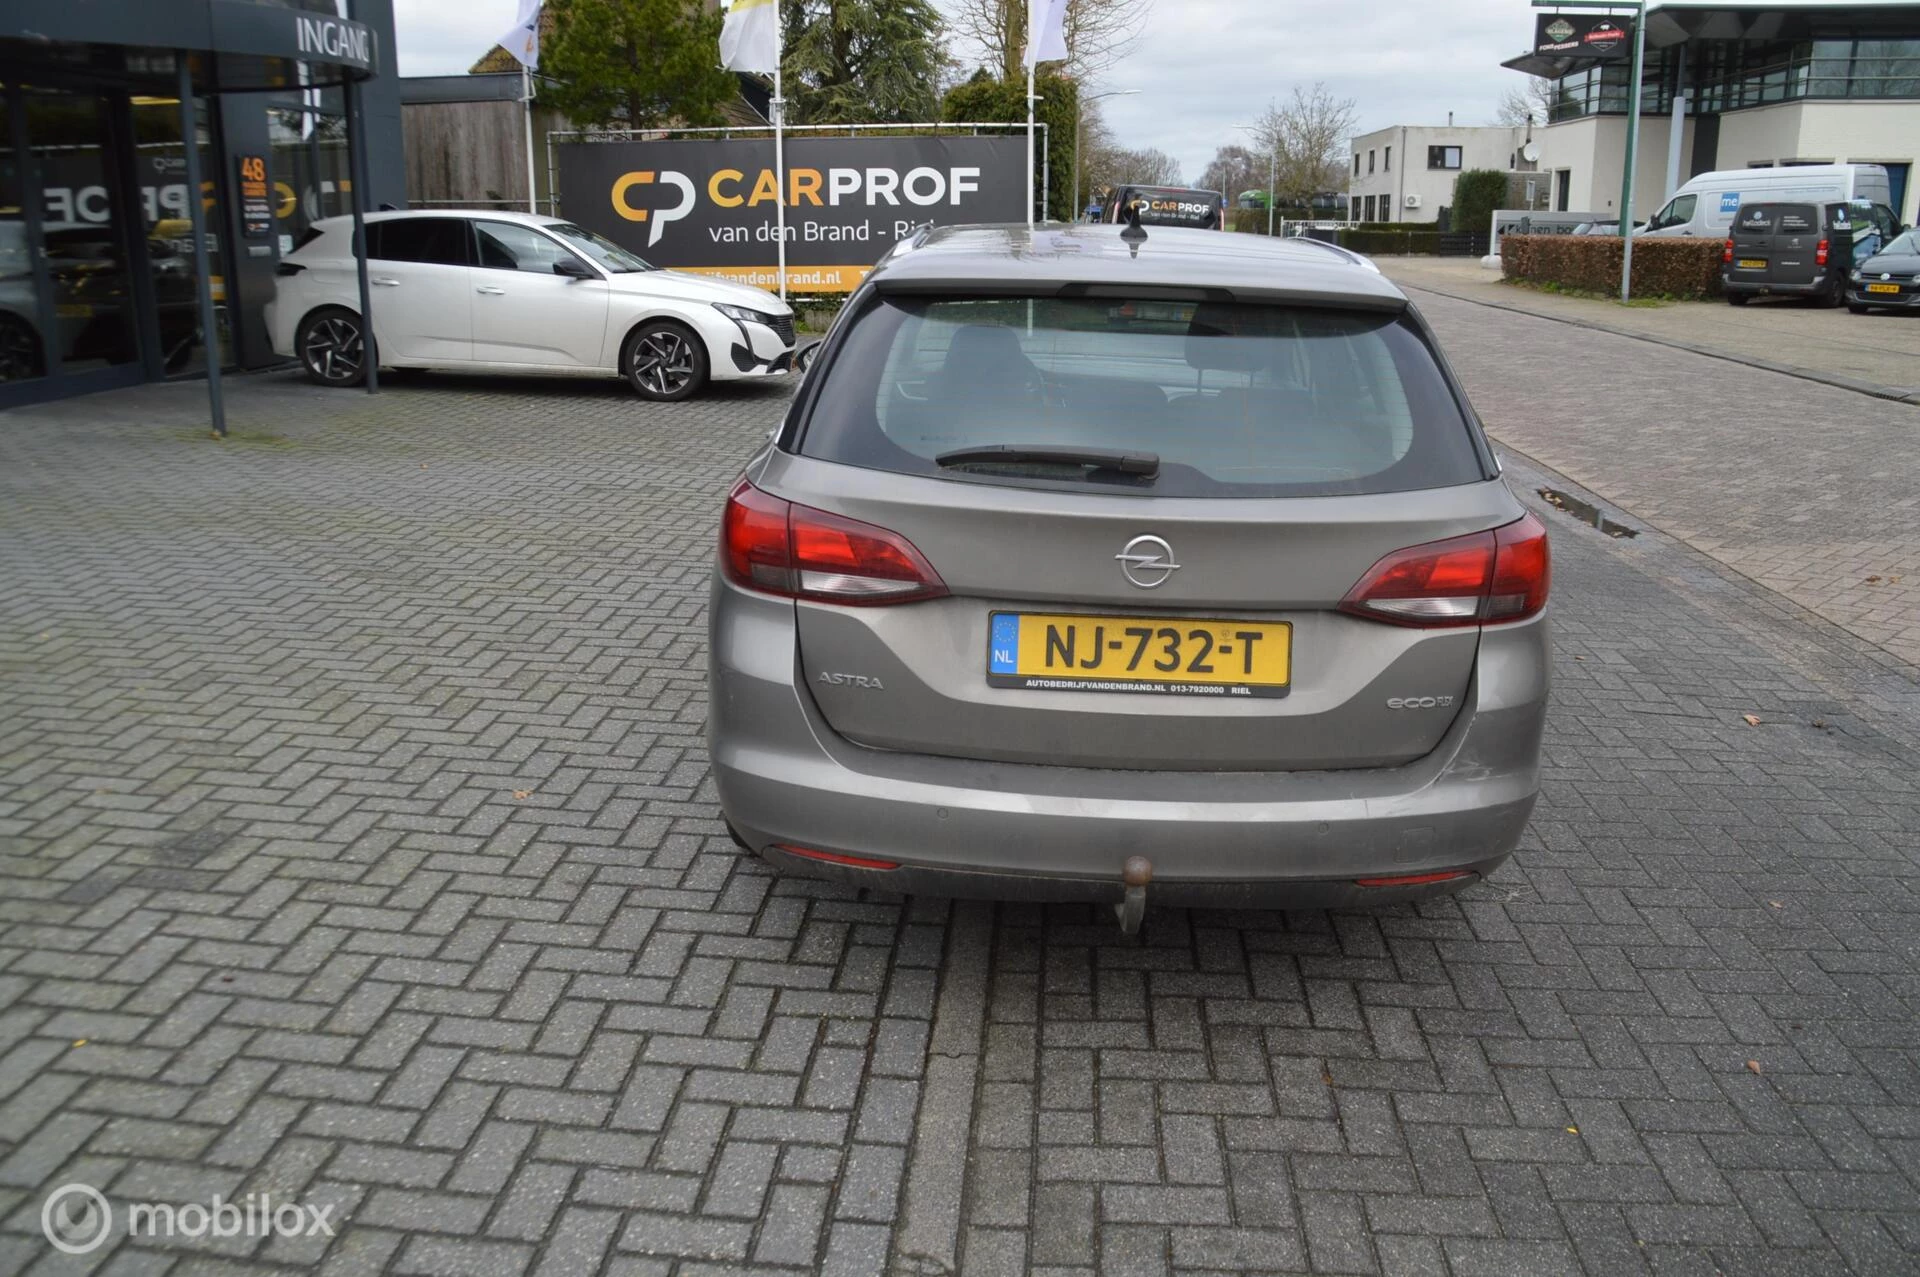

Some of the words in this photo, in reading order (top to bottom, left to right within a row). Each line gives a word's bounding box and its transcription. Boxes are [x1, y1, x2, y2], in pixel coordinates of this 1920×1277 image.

[242, 158, 265, 181] 48
[707, 166, 981, 208] CARPROF
[1151, 200, 1210, 214] CARPROF
[709, 226, 749, 243] van
[755, 221, 797, 241] den
[804, 220, 869, 241] Brand
[994, 649, 1013, 663] NL
[1044, 624, 1263, 675] NJ-732-T
[818, 671, 884, 689] ASTRA
[1026, 679, 1166, 692] AUTOBEDRIJFVANDENBRAND.NL
[1170, 685, 1224, 694] 013-7920000
[1231, 686, 1251, 695] RIEL
